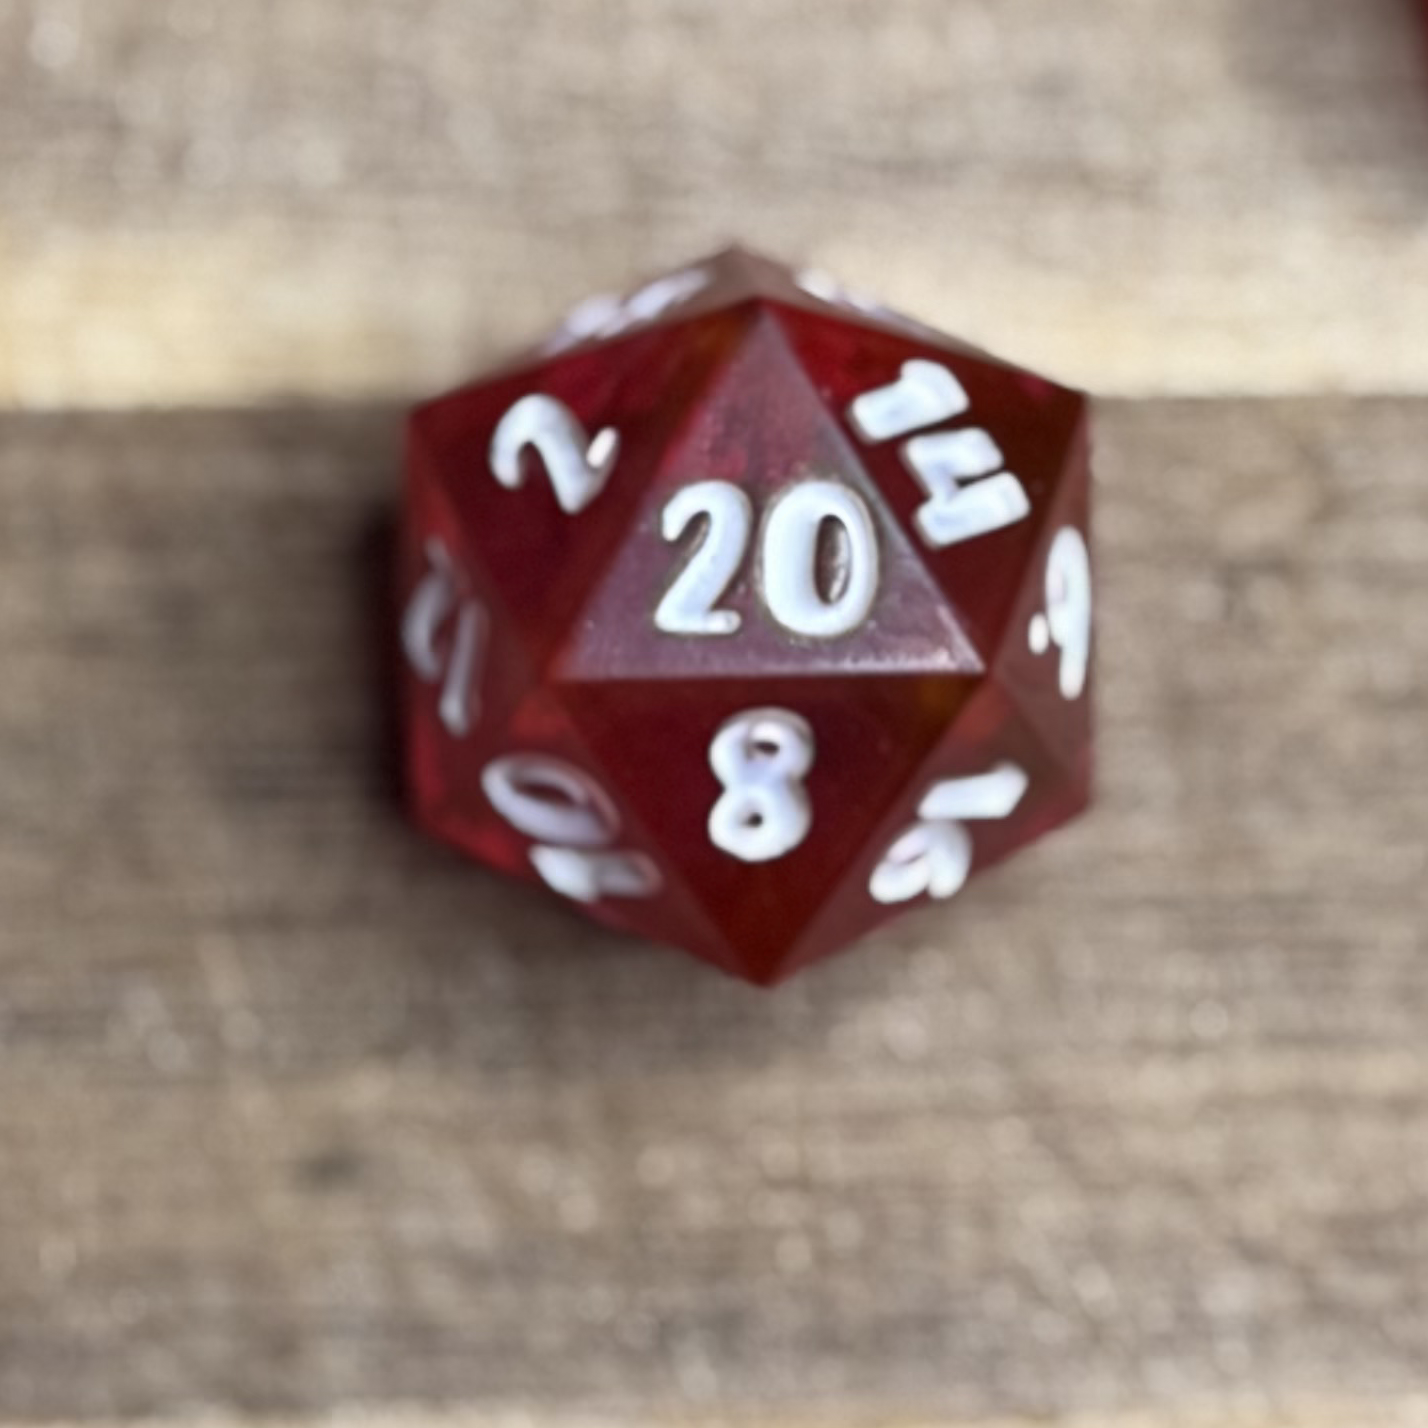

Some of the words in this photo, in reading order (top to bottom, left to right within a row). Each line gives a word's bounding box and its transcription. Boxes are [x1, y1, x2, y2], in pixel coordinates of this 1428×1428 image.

[490, 393, 618, 515] 2
[849, 358, 1030, 549] 14
[654, 479, 879, 636] 20
[708, 706, 816, 863] 8
